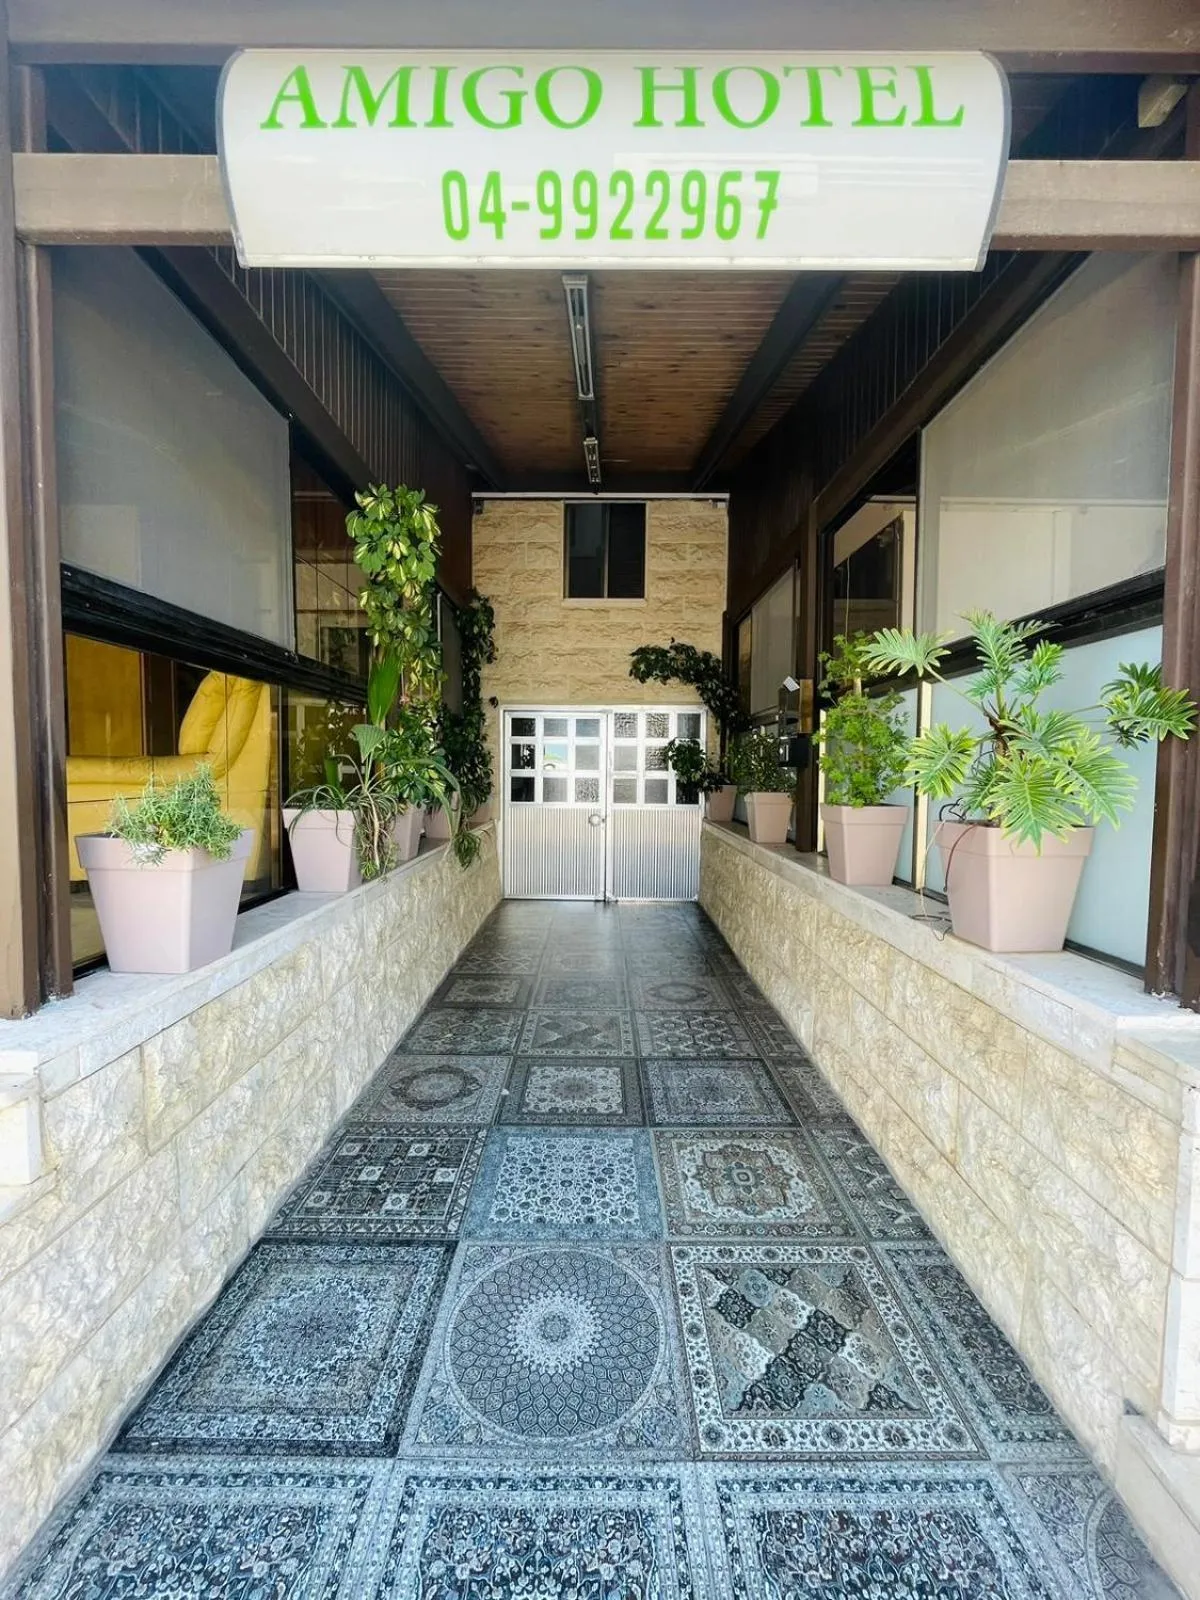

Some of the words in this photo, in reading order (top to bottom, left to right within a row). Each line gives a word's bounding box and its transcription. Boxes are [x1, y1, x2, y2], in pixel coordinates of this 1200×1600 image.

[261, 65, 603, 129] AMIGO
[633, 65, 965, 128] HOTEL
[441, 170, 780, 241] 04-9922967
